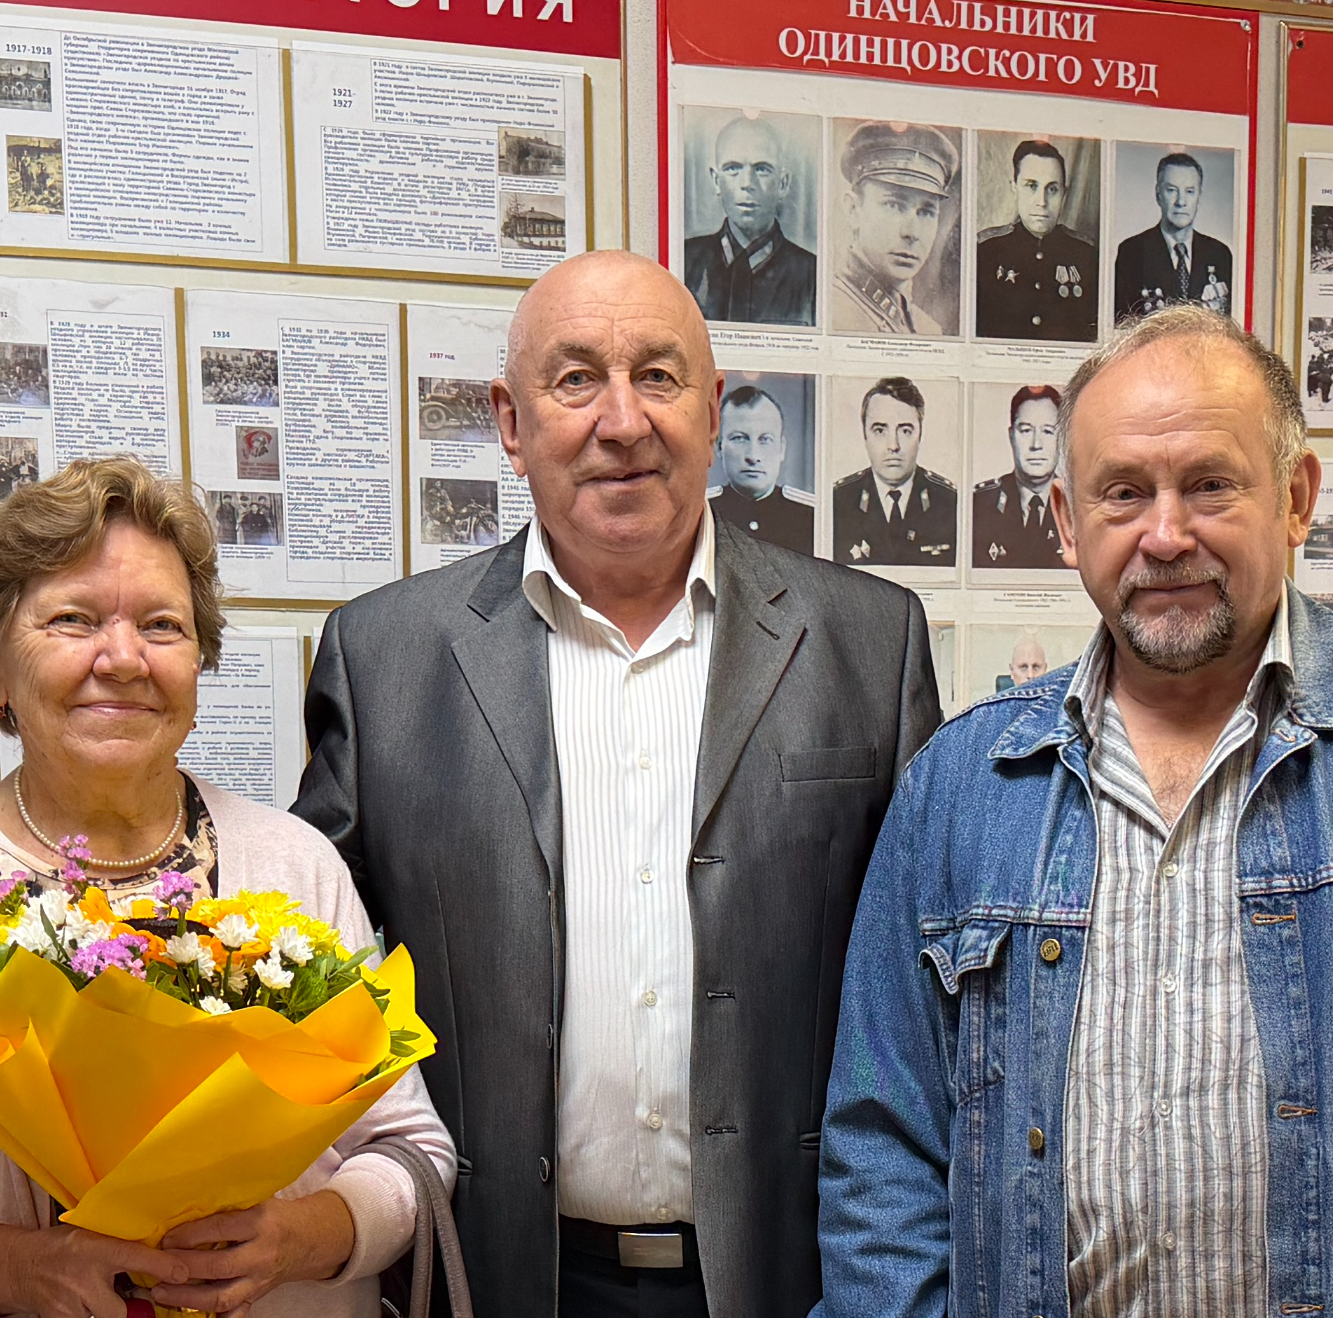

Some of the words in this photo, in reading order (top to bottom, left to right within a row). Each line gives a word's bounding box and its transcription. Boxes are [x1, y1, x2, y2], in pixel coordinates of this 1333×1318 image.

[847, 0, 1097, 43] НАЧАЛЬНИКИ
[6, 44, 52, 55] 1917-1918
[778, 28, 1082, 84] ОДИНЦОВСКОГО
[1092, 58, 1159, 98] УВД
[332, 88, 356, 97] 1921-
[332, 100, 353, 108] 1927
